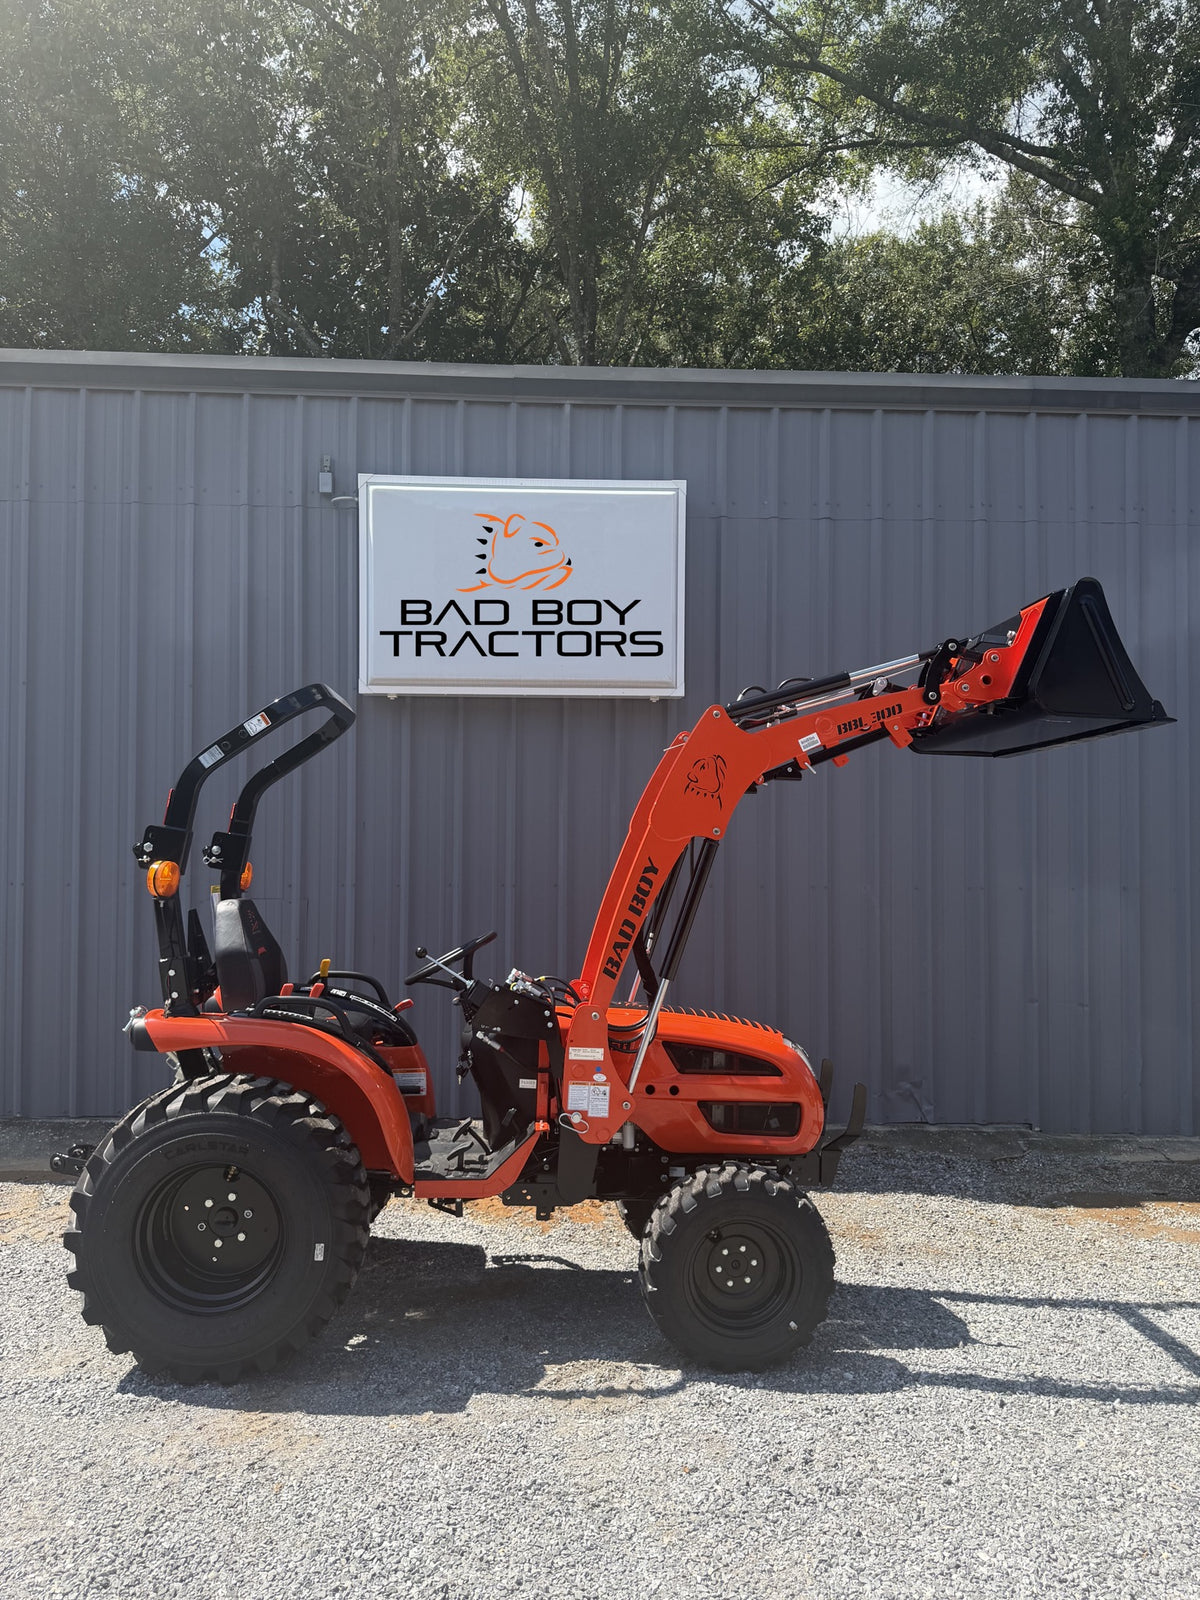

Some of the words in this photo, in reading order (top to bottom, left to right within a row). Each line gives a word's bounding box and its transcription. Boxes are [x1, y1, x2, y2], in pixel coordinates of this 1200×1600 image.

[401, 599, 510, 626] BAD
[532, 599, 642, 626] BOY
[380, 630, 664, 657] TRACTORS
[602, 918, 637, 980] BAD
[628, 856, 659, 917] BOY
[164, 1141, 250, 1160] CARLSTAR
